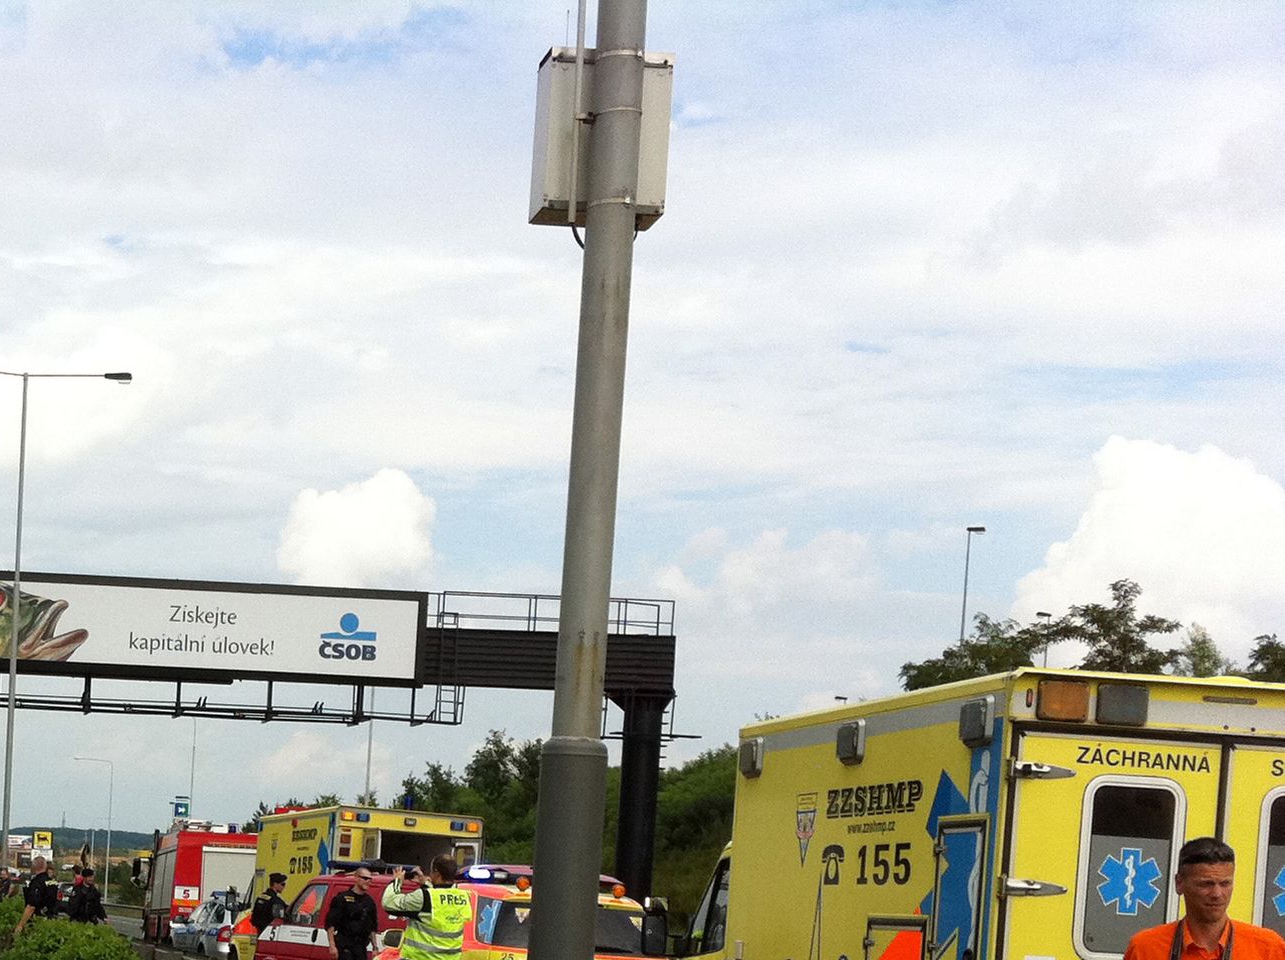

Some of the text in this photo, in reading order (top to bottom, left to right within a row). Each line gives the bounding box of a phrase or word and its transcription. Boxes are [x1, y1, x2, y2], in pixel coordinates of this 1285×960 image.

[169, 605, 237, 628] Získejte
[129, 632, 275, 656] kapitální úlovek!
[318, 641, 376, 661] ČSOB
[1076, 743, 1210, 773] ZÁCHRANNÁ
[826, 780, 923, 819] ZZSHMP
[297, 856, 313, 874] 155
[856, 843, 911, 886] 155
[183, 889, 190, 899] 5
[439, 894, 467, 905] PRESS
